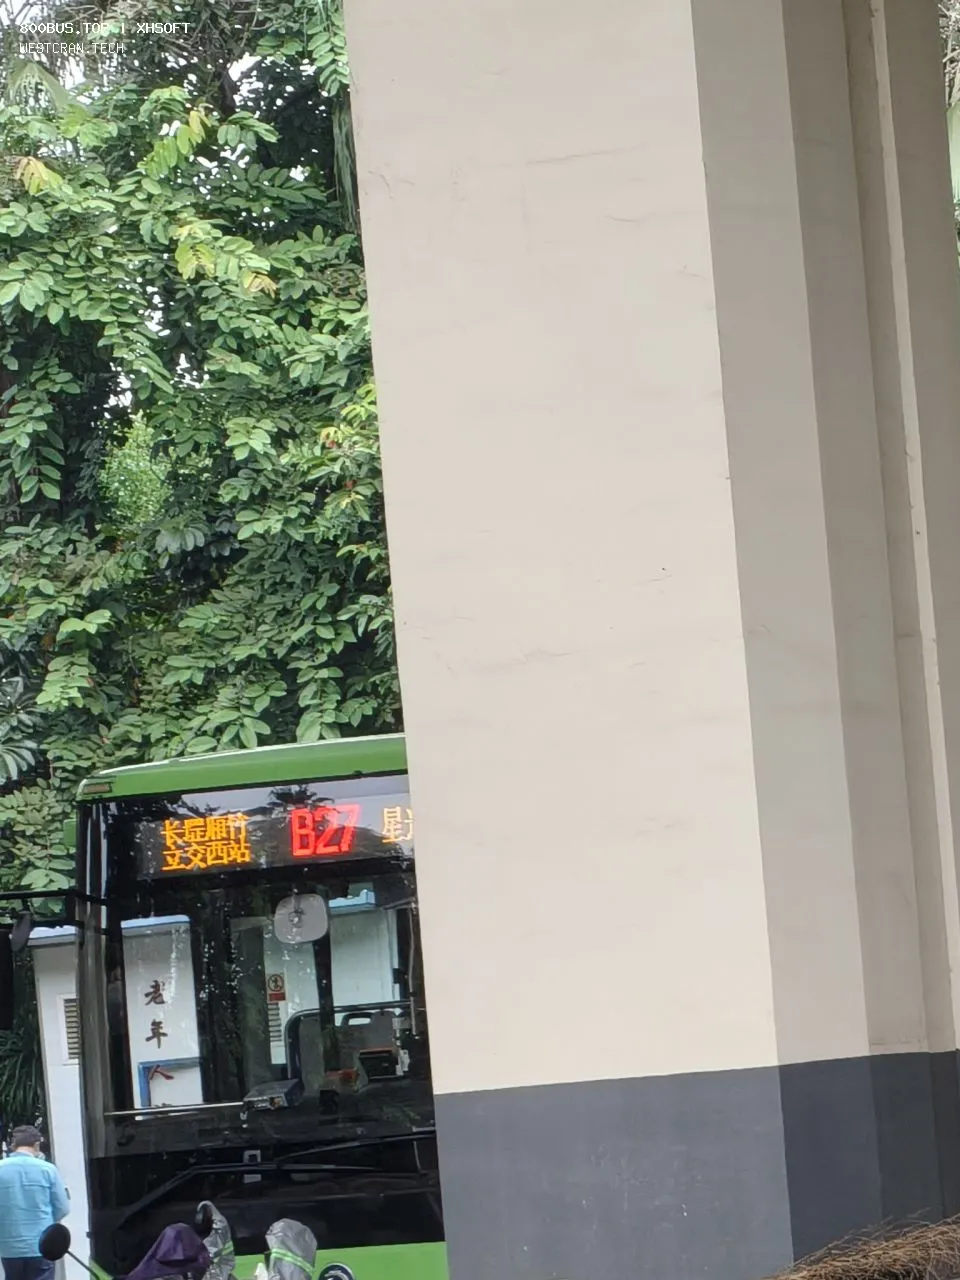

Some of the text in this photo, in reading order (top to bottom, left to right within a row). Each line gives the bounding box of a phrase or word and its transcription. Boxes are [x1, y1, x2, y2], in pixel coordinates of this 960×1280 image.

[160, 839, 251, 871] 立交西站
[290, 804, 360, 857] B27
[143, 979, 175, 1106] 老年人
